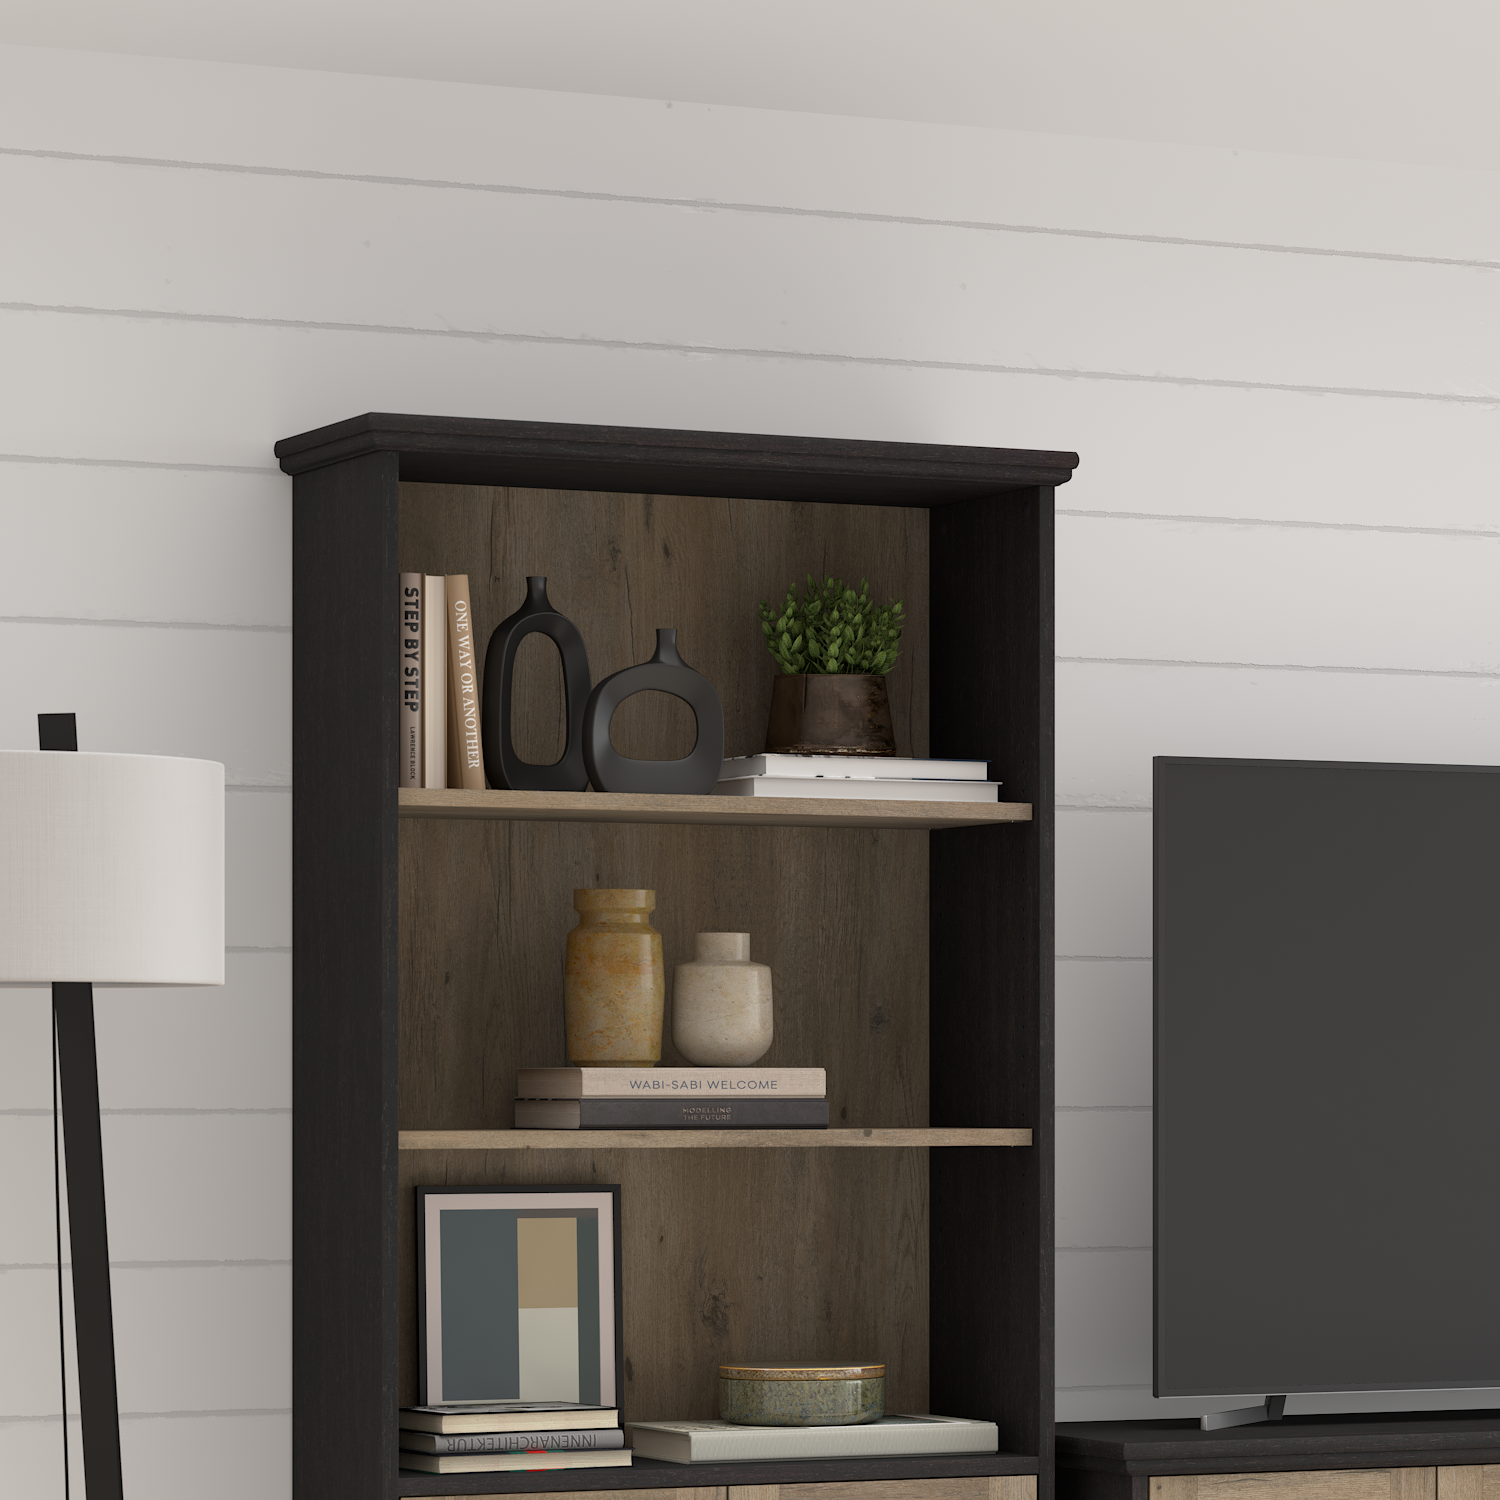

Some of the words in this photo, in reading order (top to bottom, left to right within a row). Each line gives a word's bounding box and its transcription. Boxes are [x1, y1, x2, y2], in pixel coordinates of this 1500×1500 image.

[404, 587, 419, 633] STEP
[454, 600, 468, 633] ONE
[404, 638, 419, 662] BY
[457, 635, 472, 669] WAY
[404, 666, 419, 712] STEP
[460, 672, 474, 694] OR
[463, 697, 480, 769] ANOTHER
[629, 1080, 702, 1090] WABI-SABI
[707, 1080, 778, 1090] WELCOME
[446, 1434, 597, 1452] INNENARCHITEKTUR
